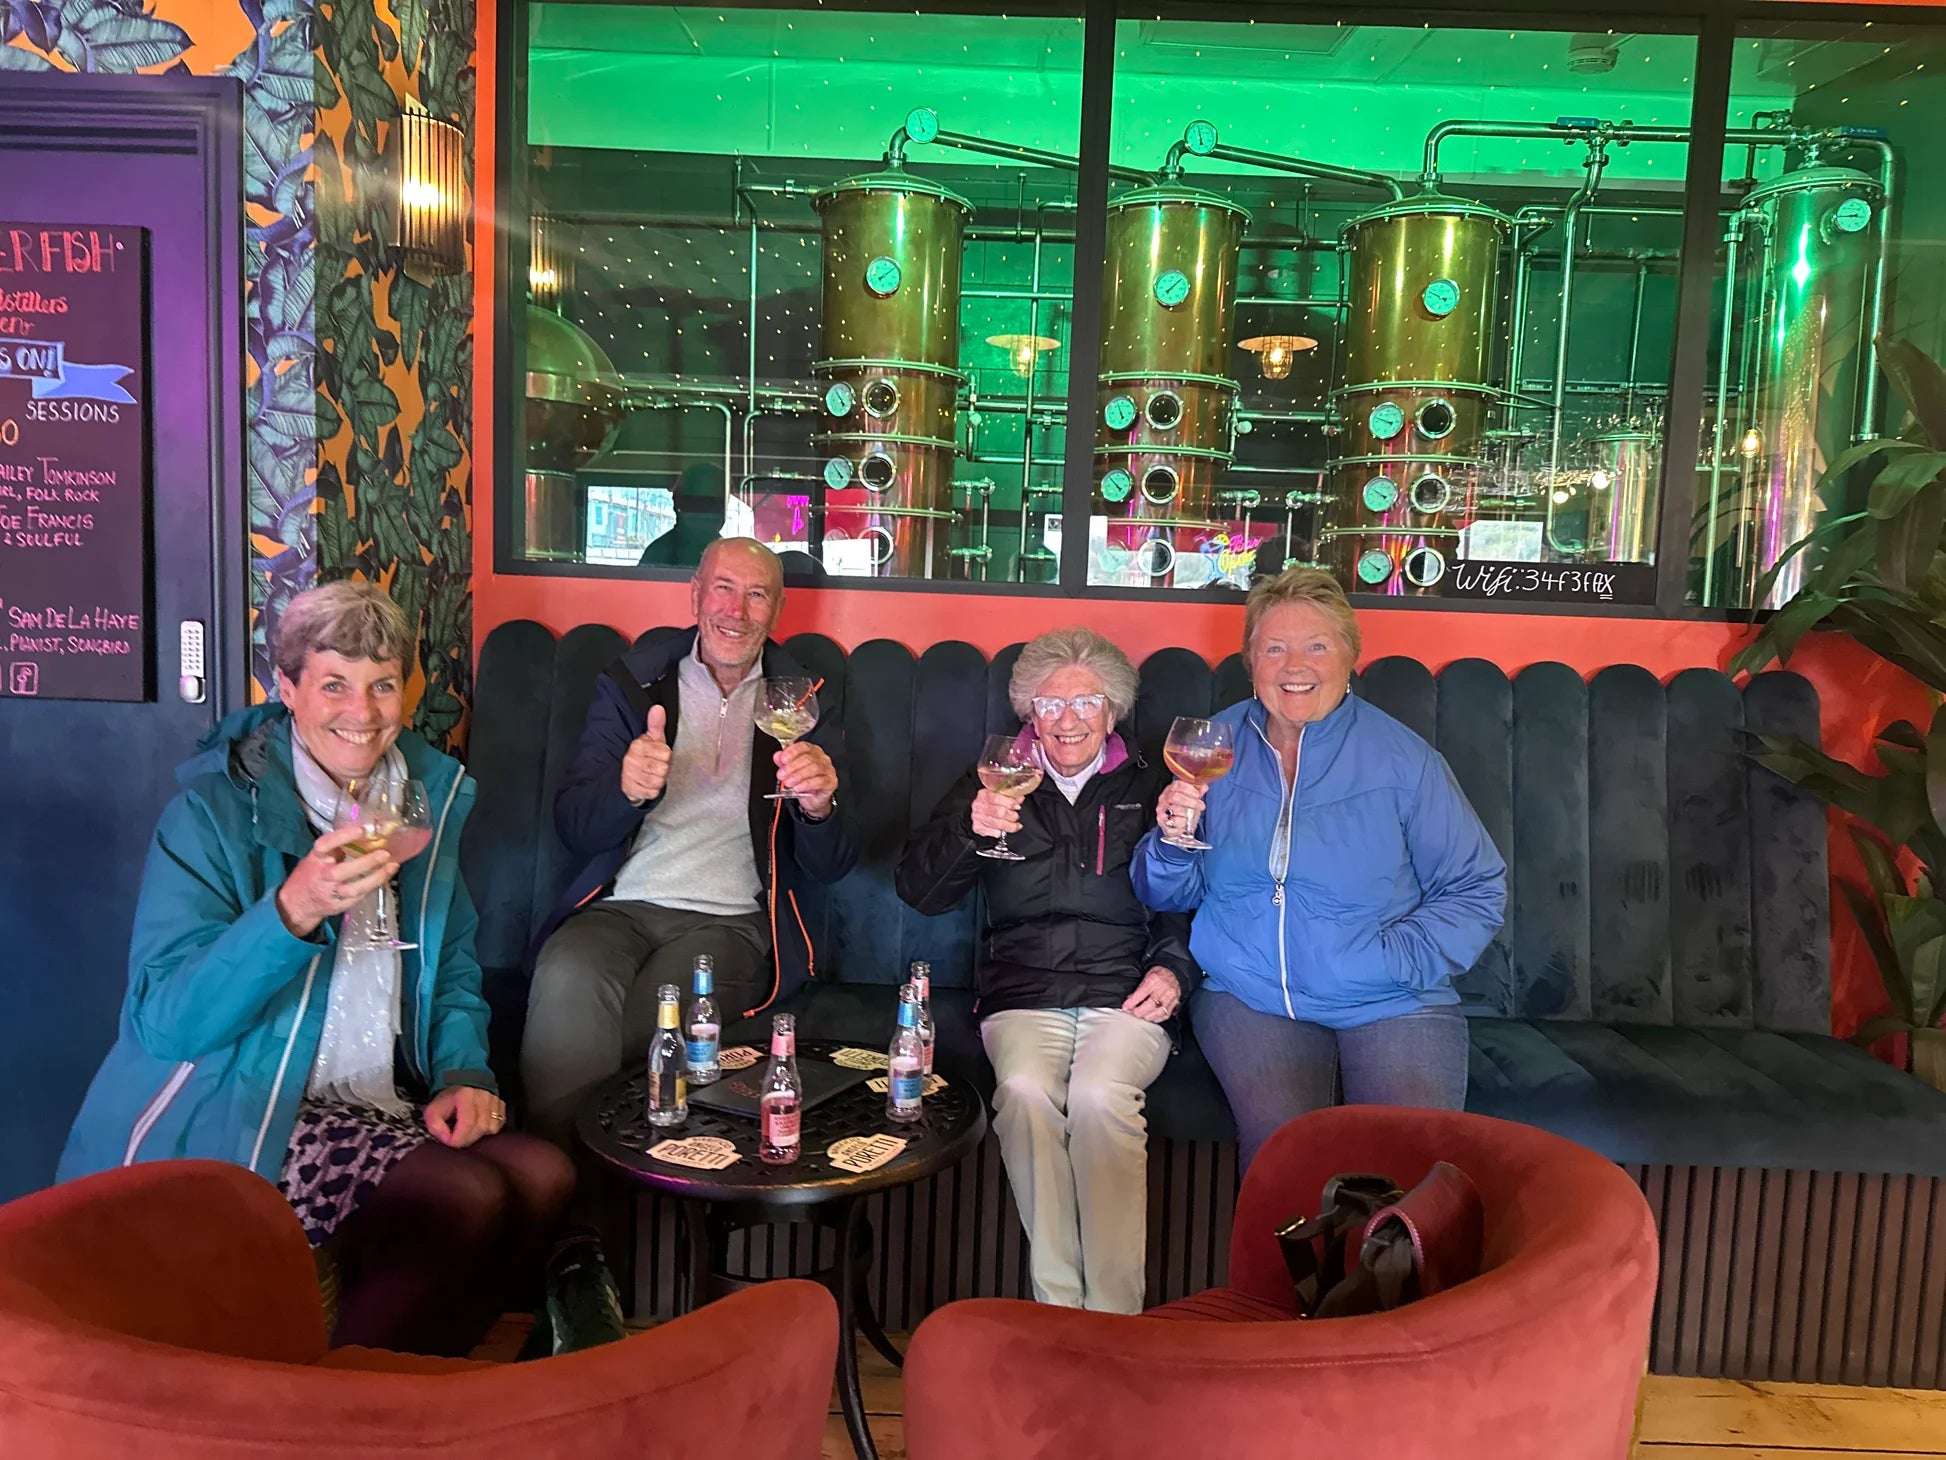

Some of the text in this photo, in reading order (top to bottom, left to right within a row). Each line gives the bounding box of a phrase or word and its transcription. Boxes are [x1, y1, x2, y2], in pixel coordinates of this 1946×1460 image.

[25, 400, 120, 423] SESSIONS
[26, 487, 61, 502] FOLK
[64, 488, 100, 503] ROCK
[27, 505, 94, 530] FRANCIS
[15, 531, 84, 548] SOULFUL
[94, 606, 140, 631] HAYE
[657, 1143, 729, 1166] PORETTI
[843, 1137, 899, 1168] PORETTI
